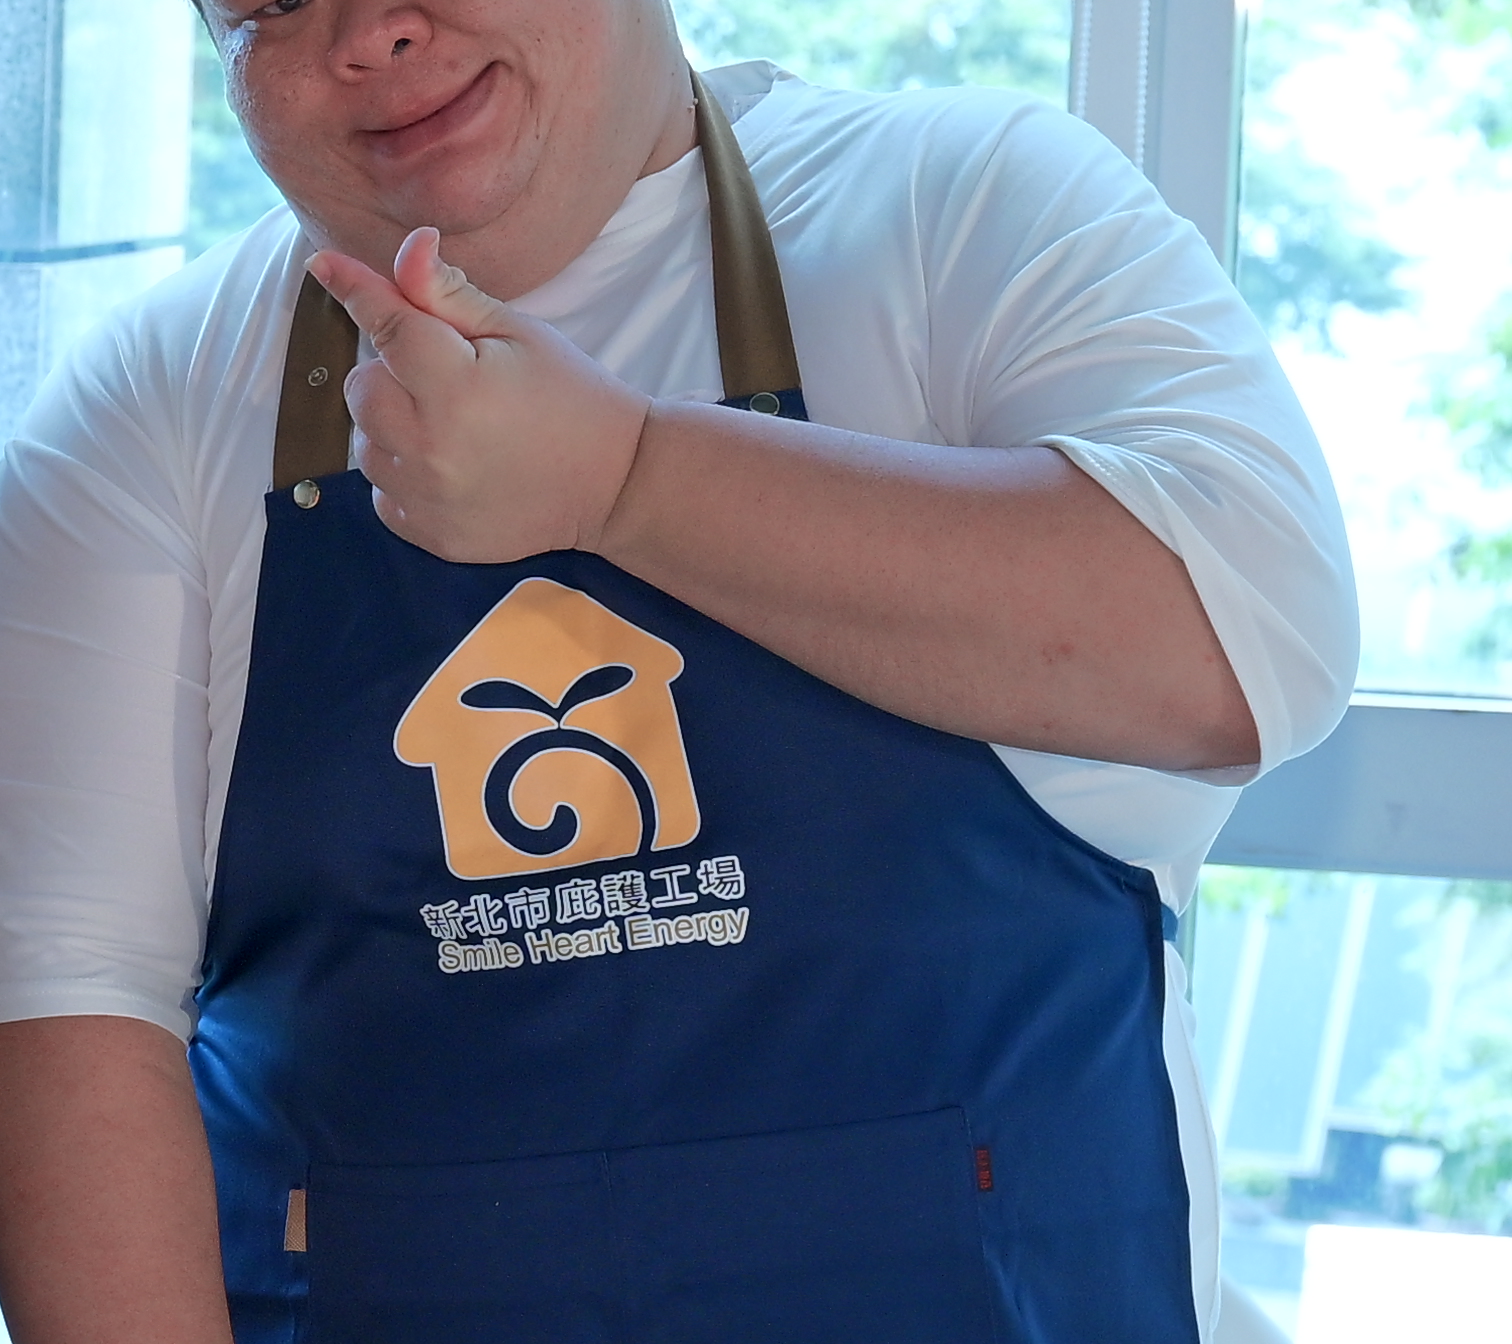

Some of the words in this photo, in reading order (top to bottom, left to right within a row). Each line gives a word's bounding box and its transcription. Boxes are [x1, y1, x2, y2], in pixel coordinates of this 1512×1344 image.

[419, 855, 746, 941] 新北市庇護工場
[438, 939, 523, 974] Smile
[525, 923, 622, 964] Heart
[626, 906, 750, 946] Energy
